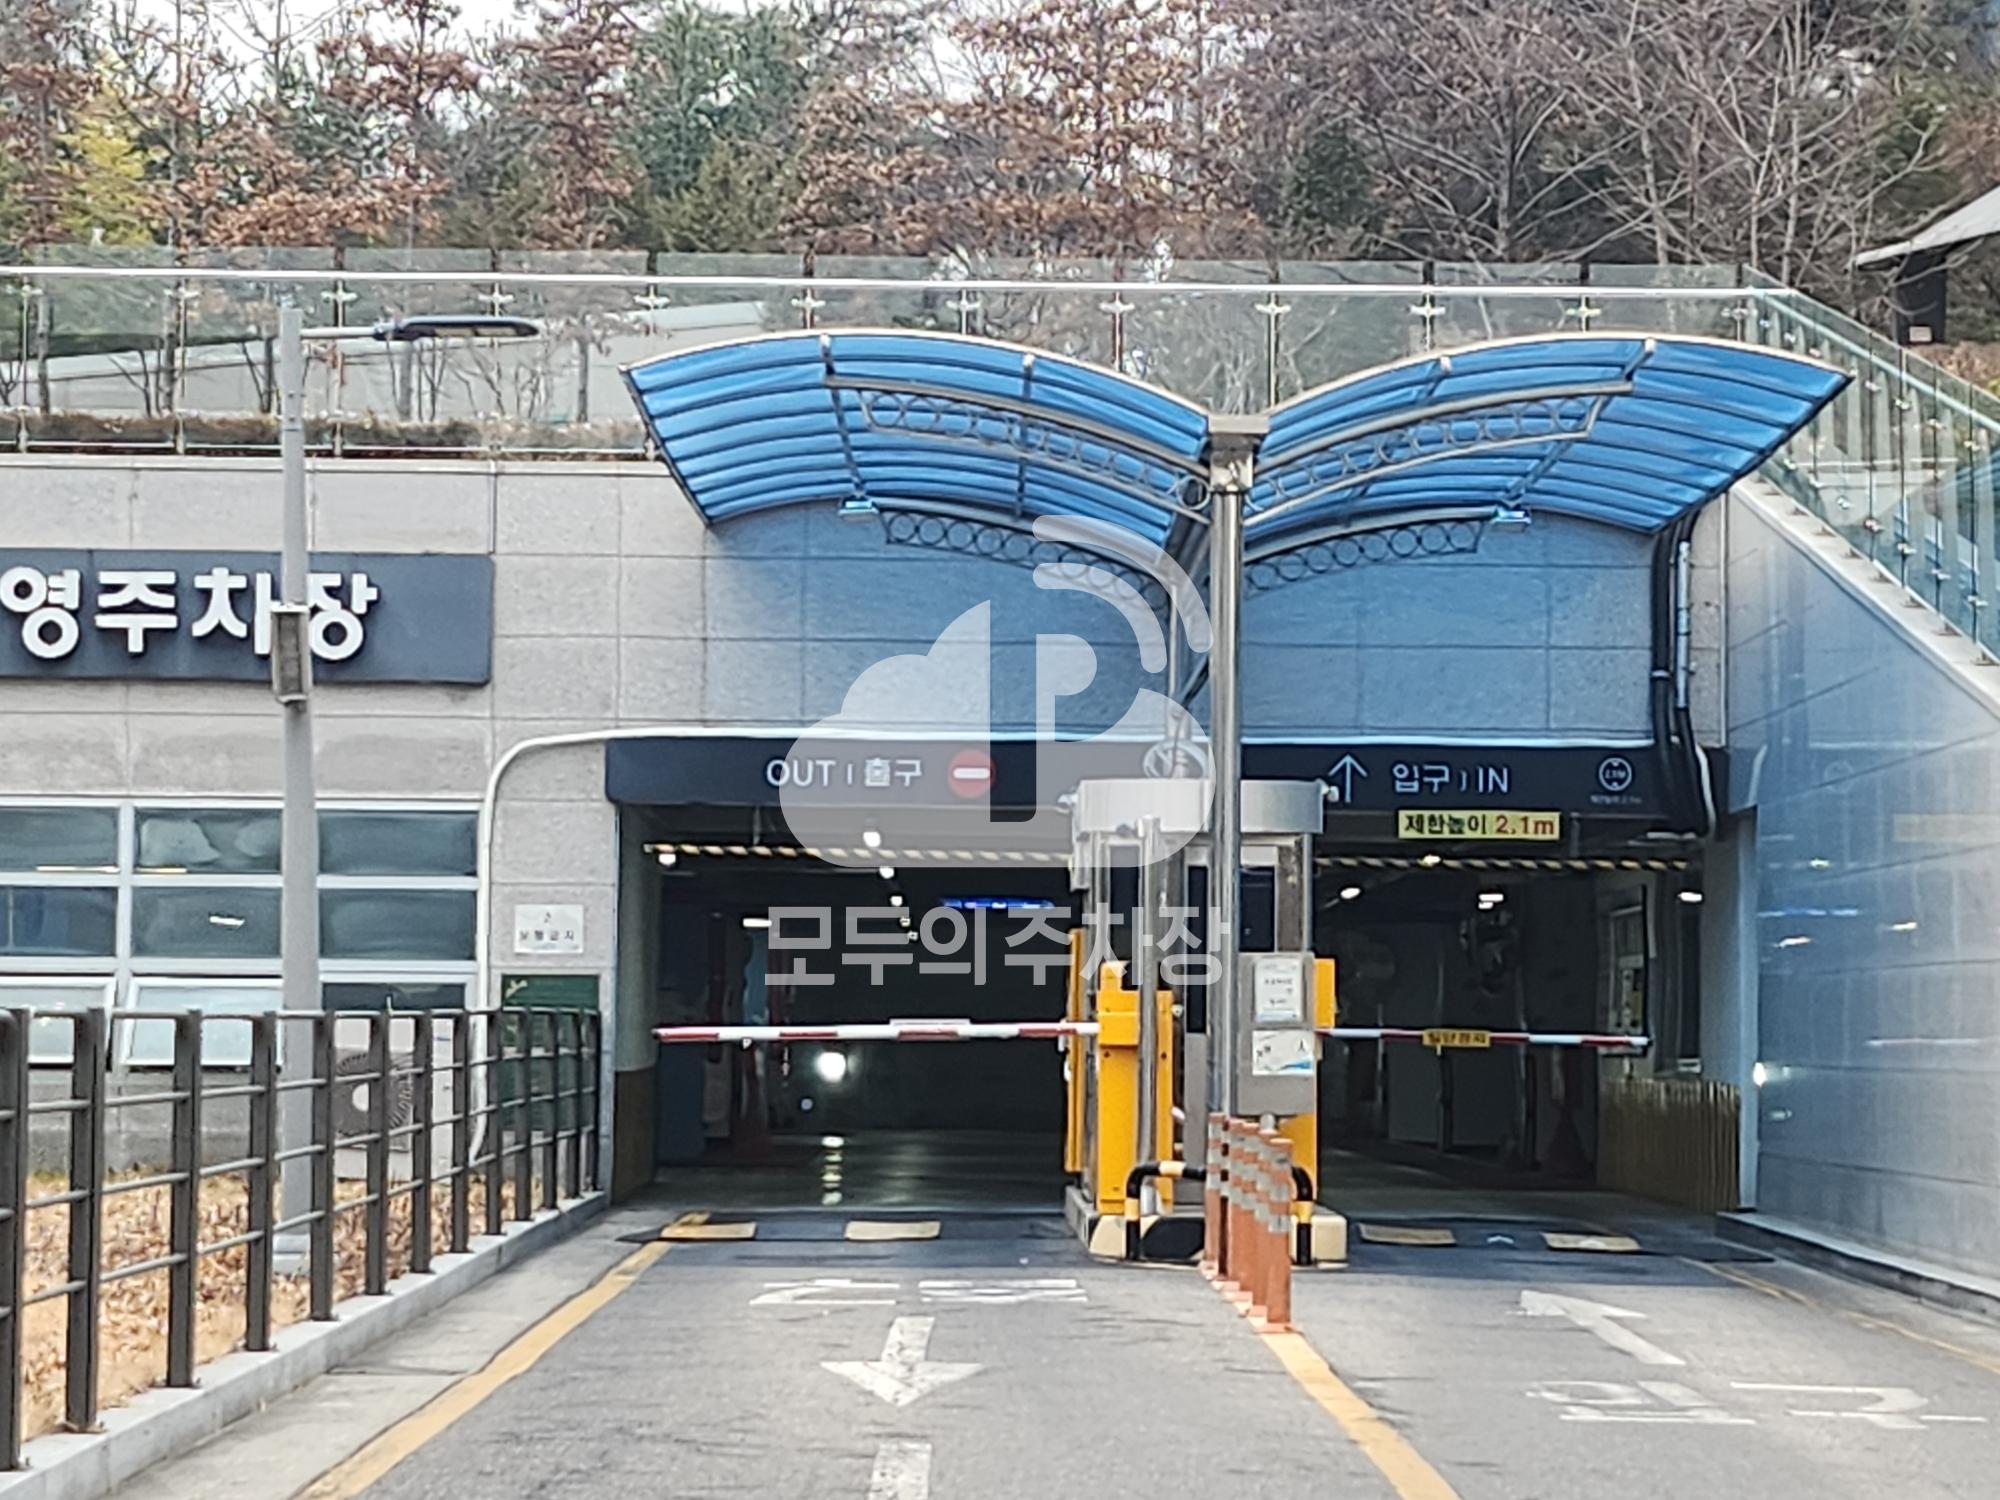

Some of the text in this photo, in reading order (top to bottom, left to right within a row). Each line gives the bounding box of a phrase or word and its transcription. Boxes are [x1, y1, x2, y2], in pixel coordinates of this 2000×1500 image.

[0, 567, 379, 660] 영주차장
[766, 757, 922, 788] OUT 출구
[1392, 763, 1509, 793] 입구 IN
[1495, 814, 1555, 835] 2.1m
